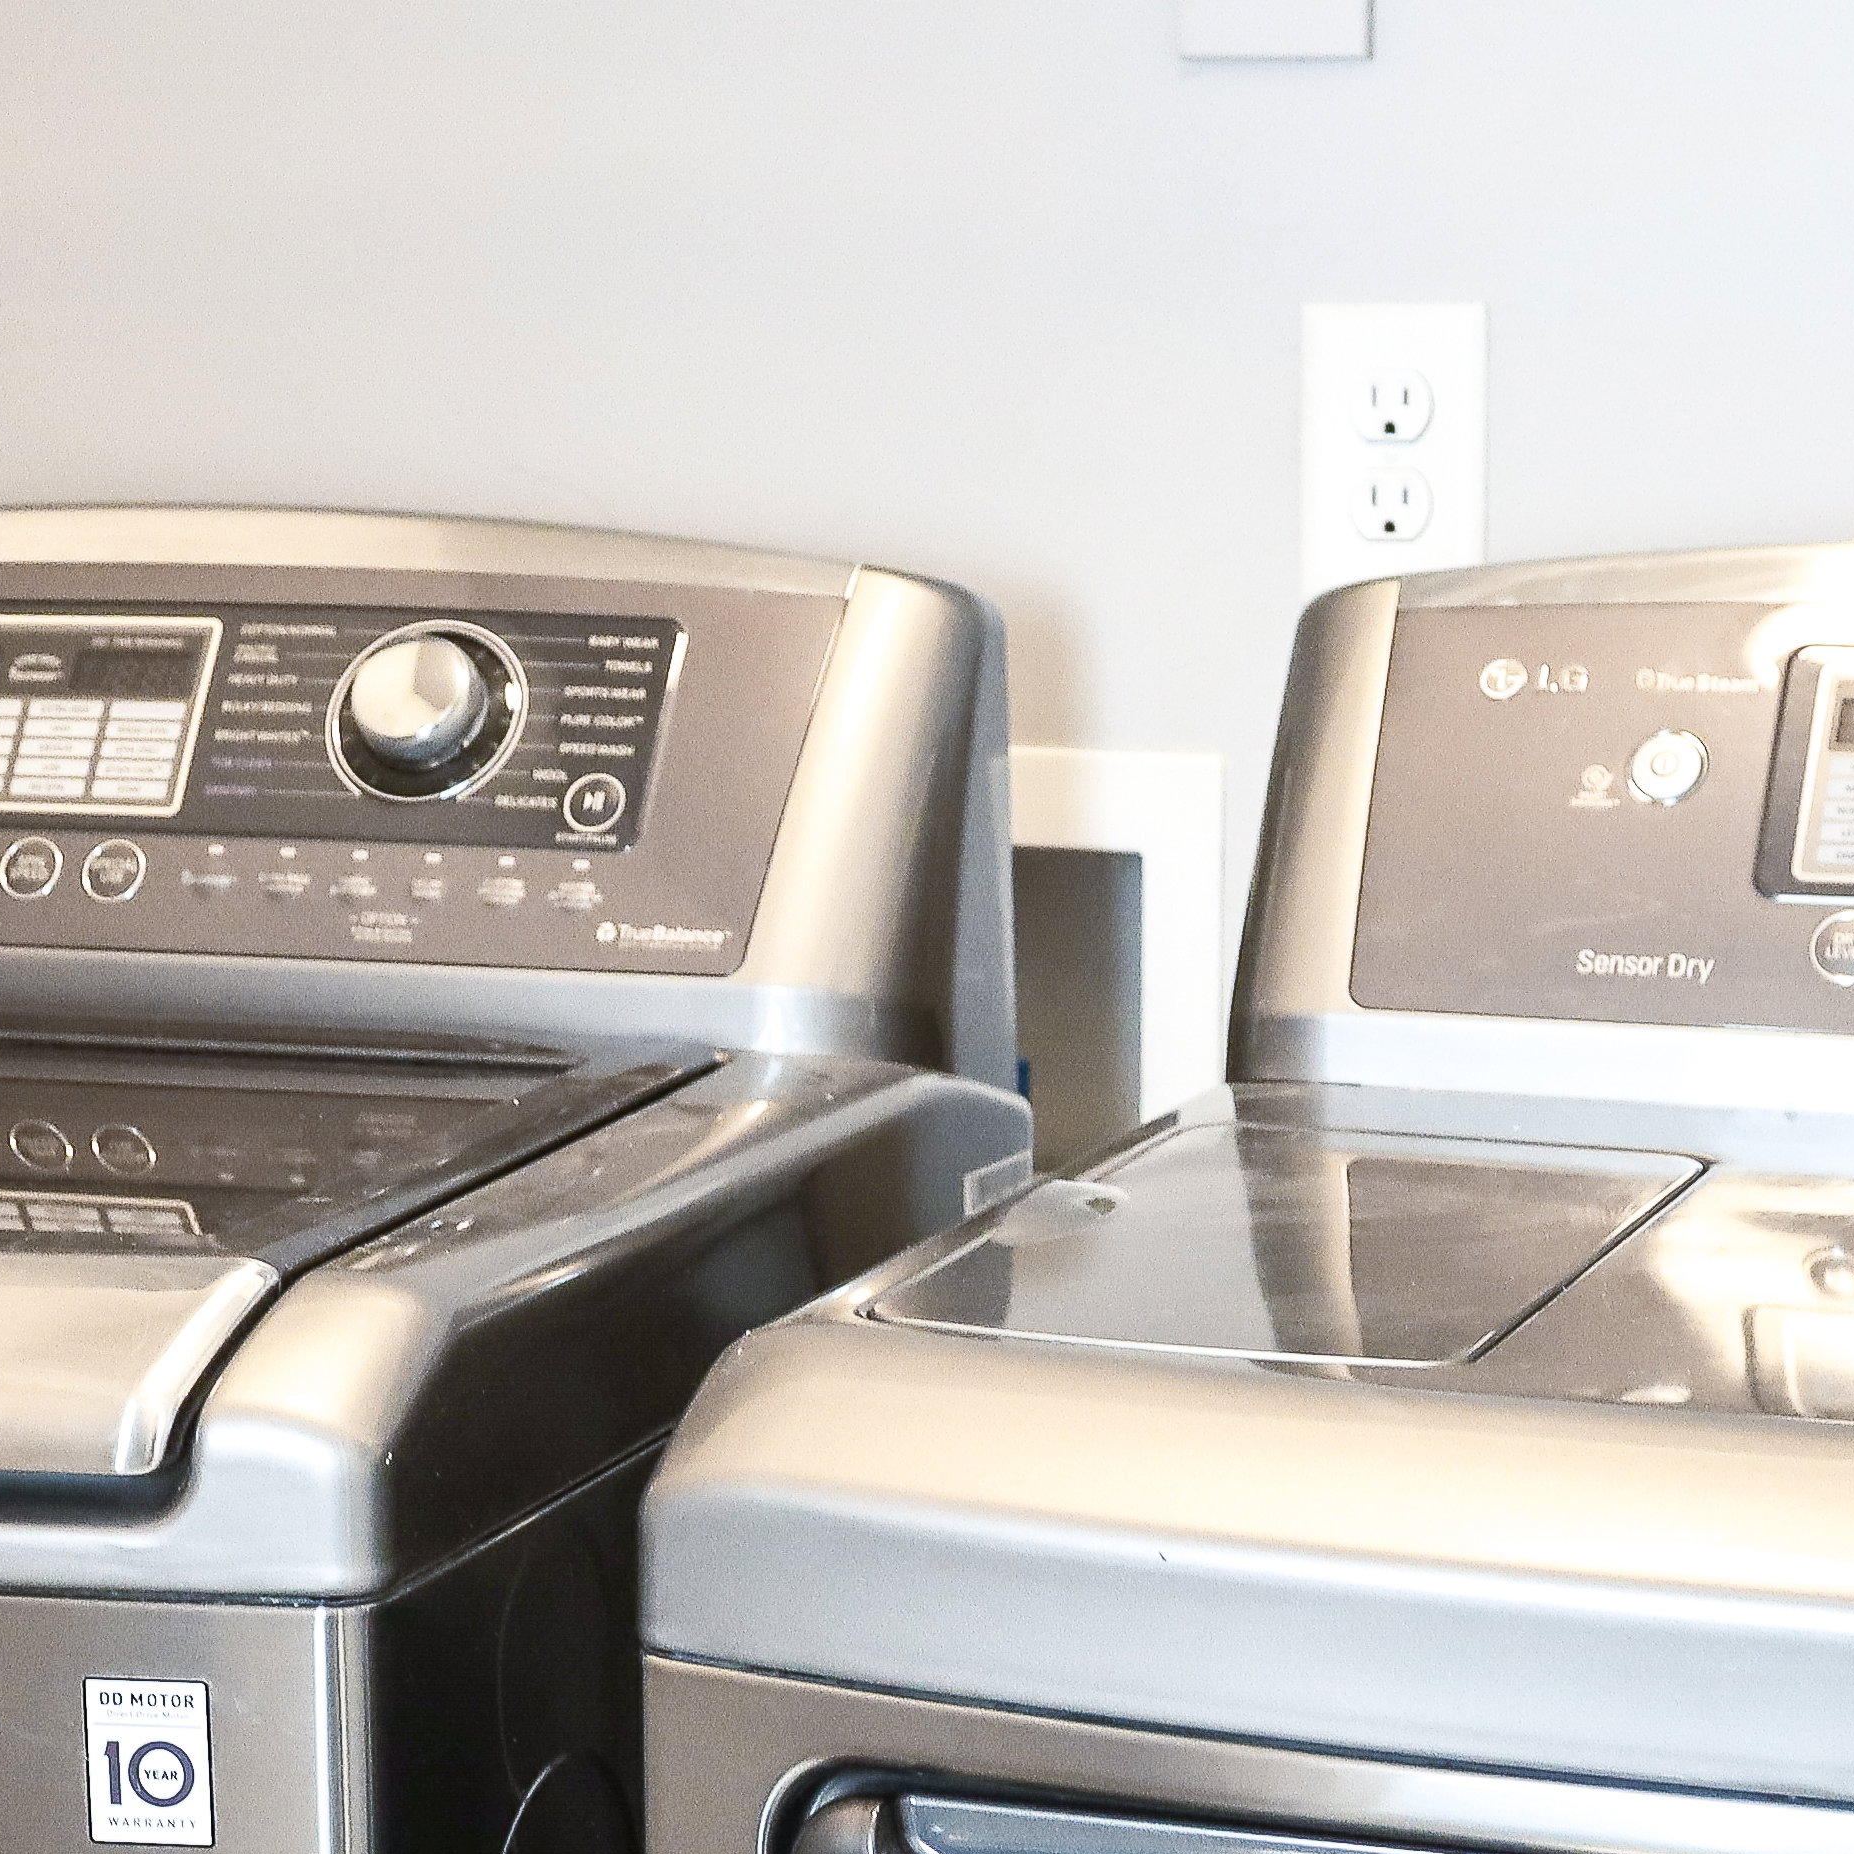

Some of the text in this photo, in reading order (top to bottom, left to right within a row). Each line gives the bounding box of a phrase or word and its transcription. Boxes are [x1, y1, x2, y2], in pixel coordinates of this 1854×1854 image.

[1576, 949, 1715, 984] Sensor Dry
[99, 1691, 195, 1709] DD MOTOR
[104, 1741, 195, 1807] 10
[143, 1769, 178, 1781] YEAR
[109, 1816, 196, 1830] WARRANTY
